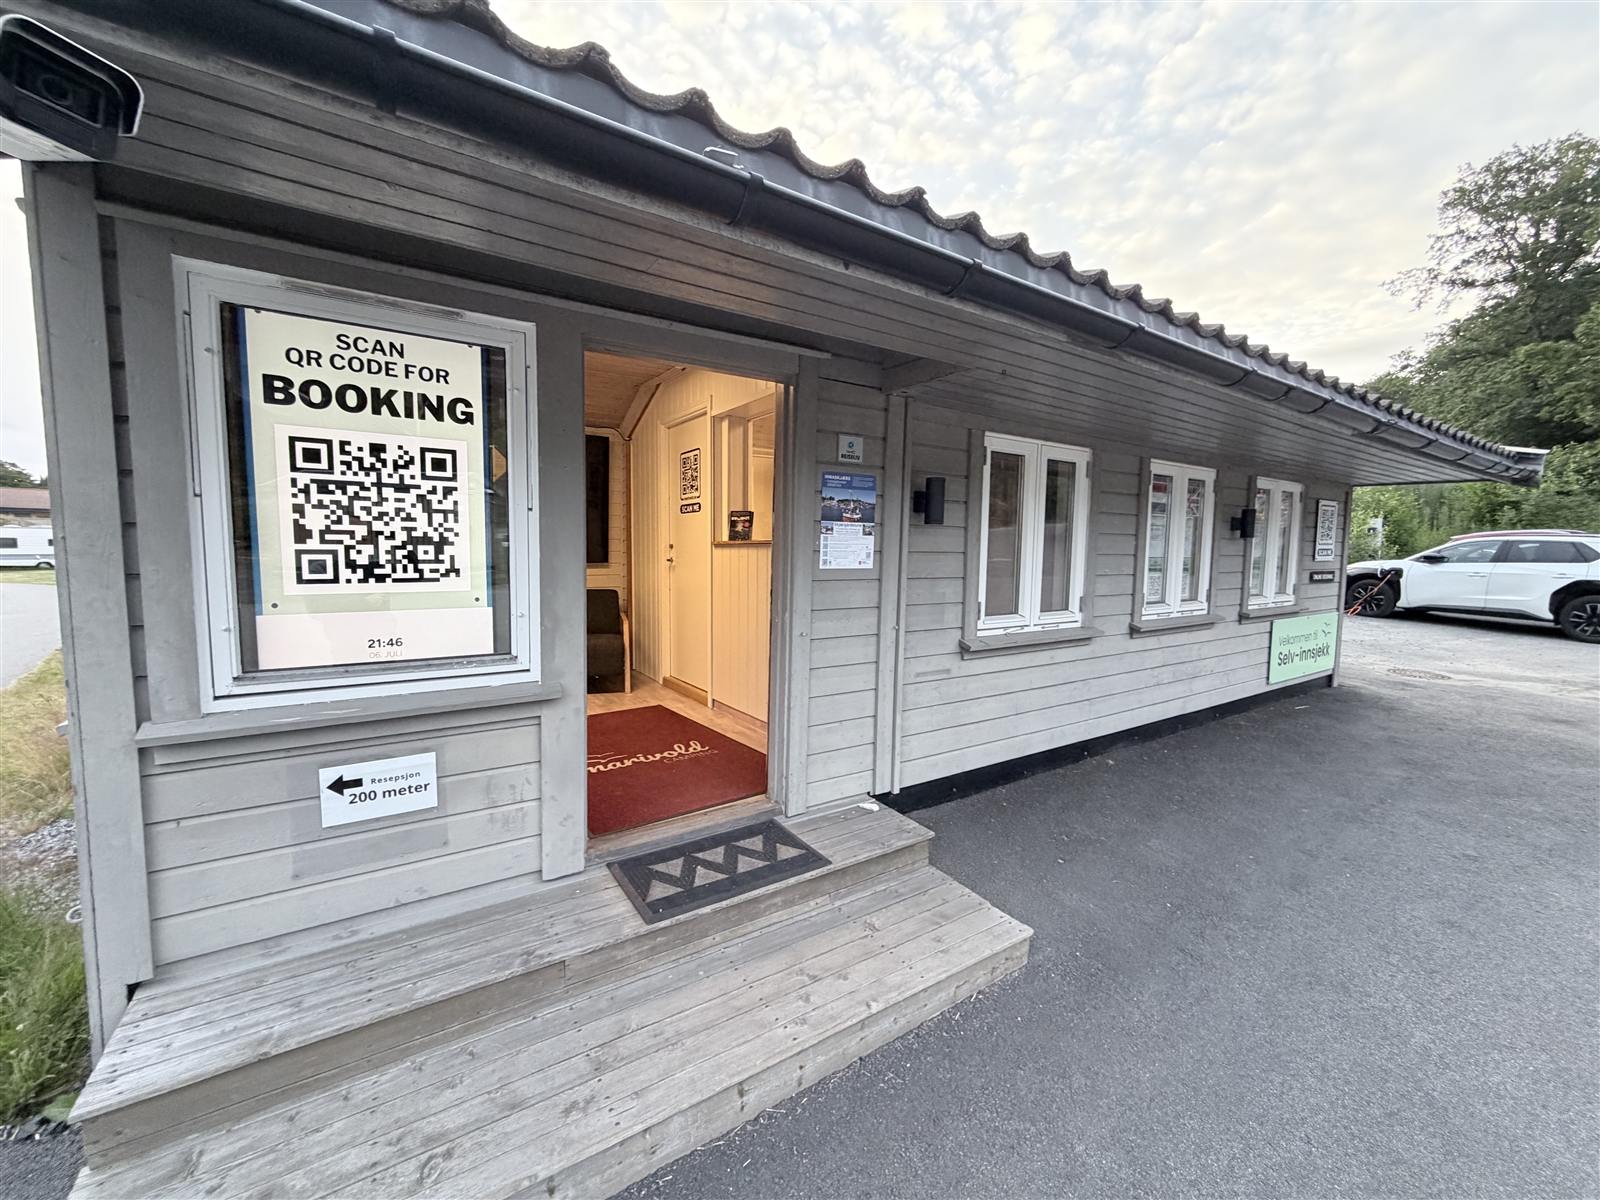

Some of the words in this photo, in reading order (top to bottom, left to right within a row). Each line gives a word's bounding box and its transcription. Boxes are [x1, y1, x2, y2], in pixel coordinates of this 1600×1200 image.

[335, 333, 405, 359] SCAN
[285, 347, 322, 368] QR
[329, 353, 398, 378] CODE
[404, 363, 450, 385] FOR
[262, 373, 475, 425] BOOKING
[681, 504, 692, 513] SCAN
[693, 503, 700, 512] ME
[367, 637, 403, 649] 21:46
[1279, 631, 1312, 646] Velkommen
[1277, 642, 1330, 667] Selv-innsjekk
[370, 771, 421, 785] Resepsjon
[348, 790, 377, 804] 200
[382, 782, 431, 799] meter
